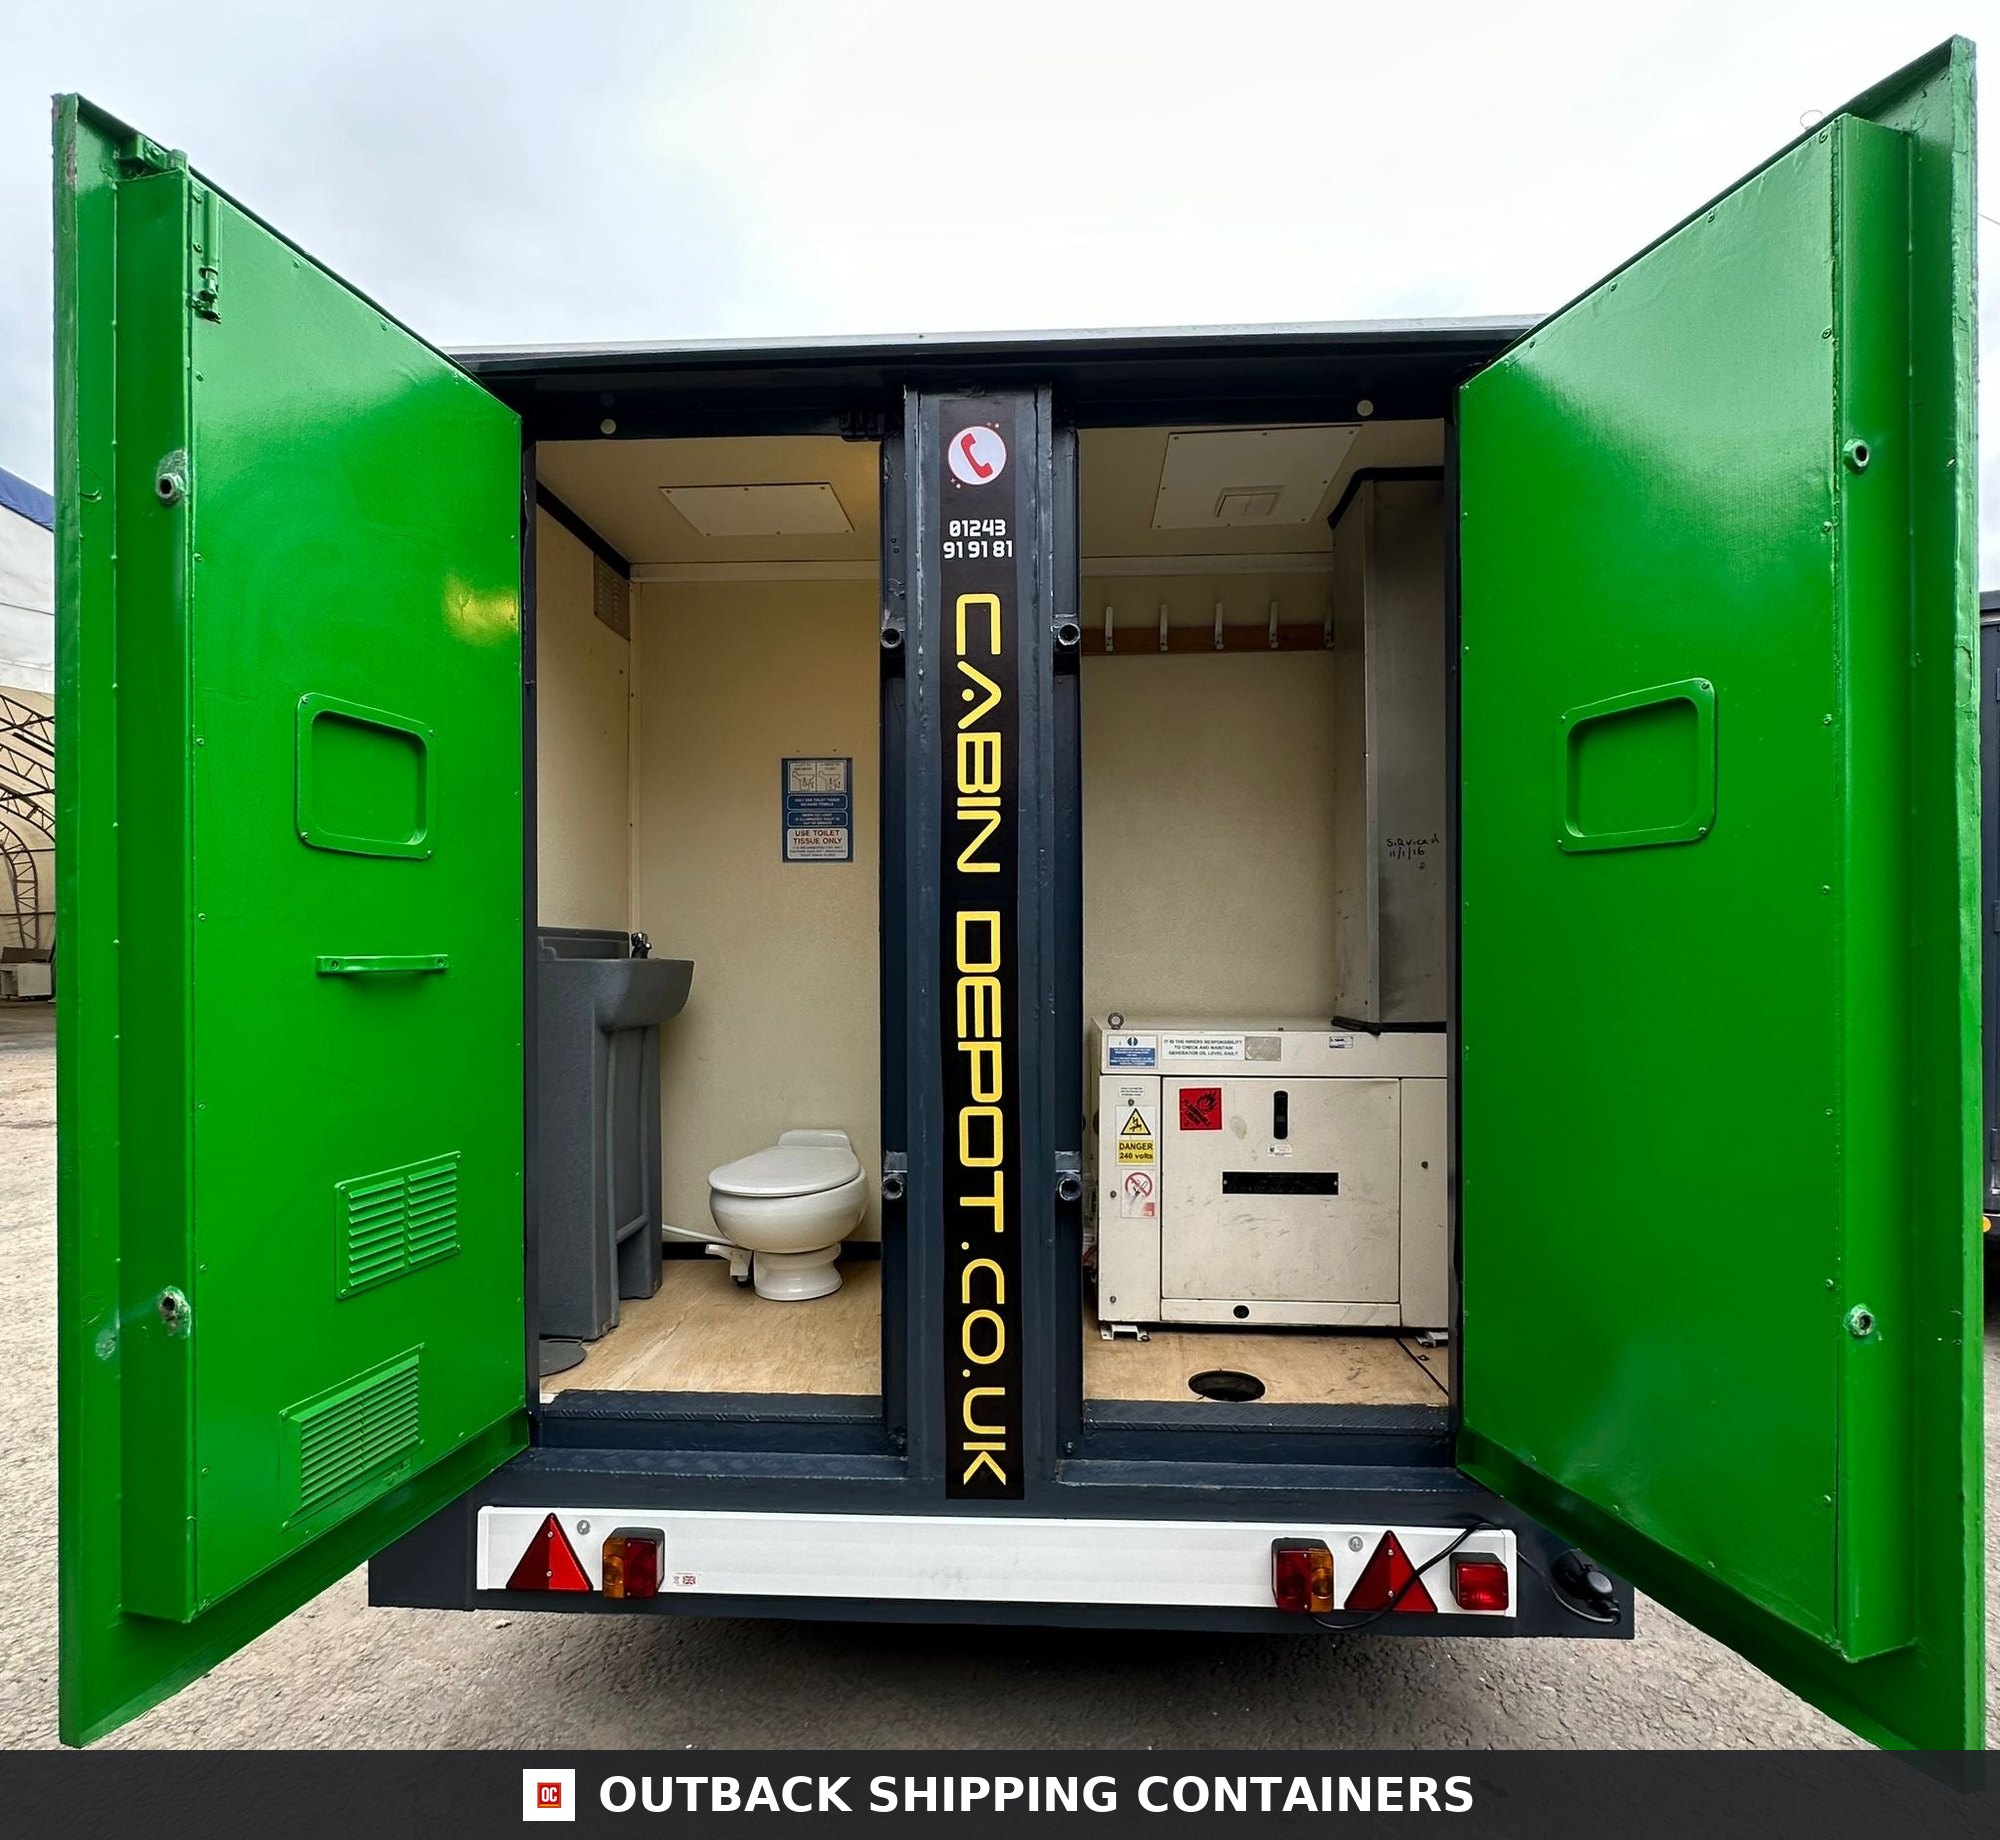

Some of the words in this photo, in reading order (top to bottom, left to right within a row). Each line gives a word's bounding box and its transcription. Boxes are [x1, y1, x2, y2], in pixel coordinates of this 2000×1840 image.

[949, 519, 1006, 537] 01243
[943, 541, 963, 559] 91
[967, 541, 988, 559] 91
[992, 540, 1013, 558] 81
[956, 593, 1001, 873] CABIN
[1119, 1142, 1153, 1150] DANGER
